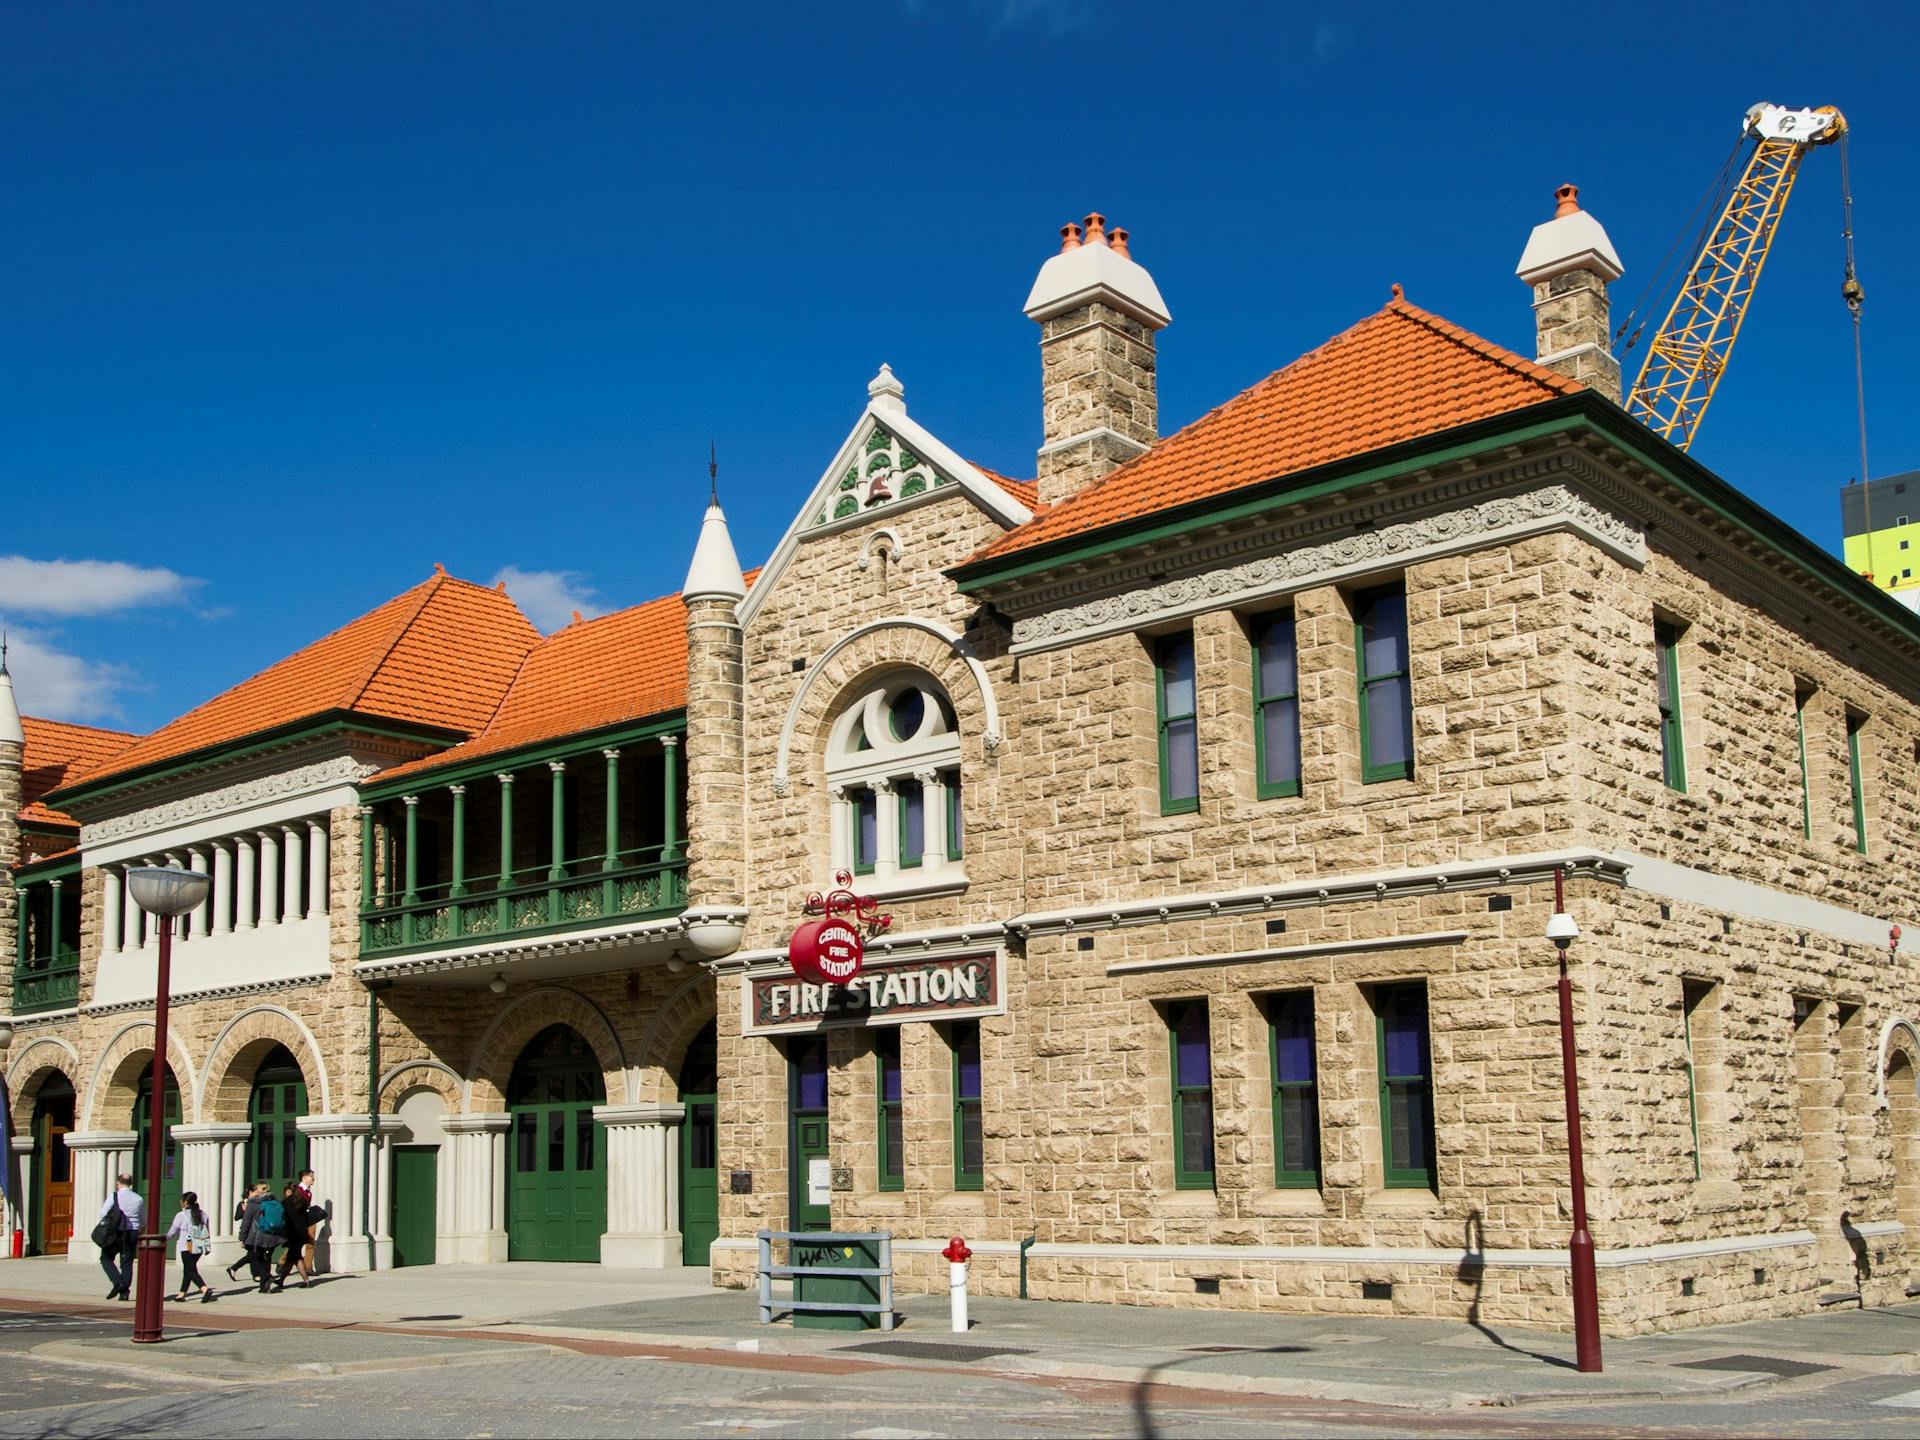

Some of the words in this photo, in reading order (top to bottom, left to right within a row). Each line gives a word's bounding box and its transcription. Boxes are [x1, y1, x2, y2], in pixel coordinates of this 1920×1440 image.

[818, 926, 858, 949] CENTRAL
[829, 946, 849, 957] FIRE
[819, 955, 857, 977] STATION
[771, 982, 840, 1017] FIRE
[847, 965, 977, 1010] STATION
